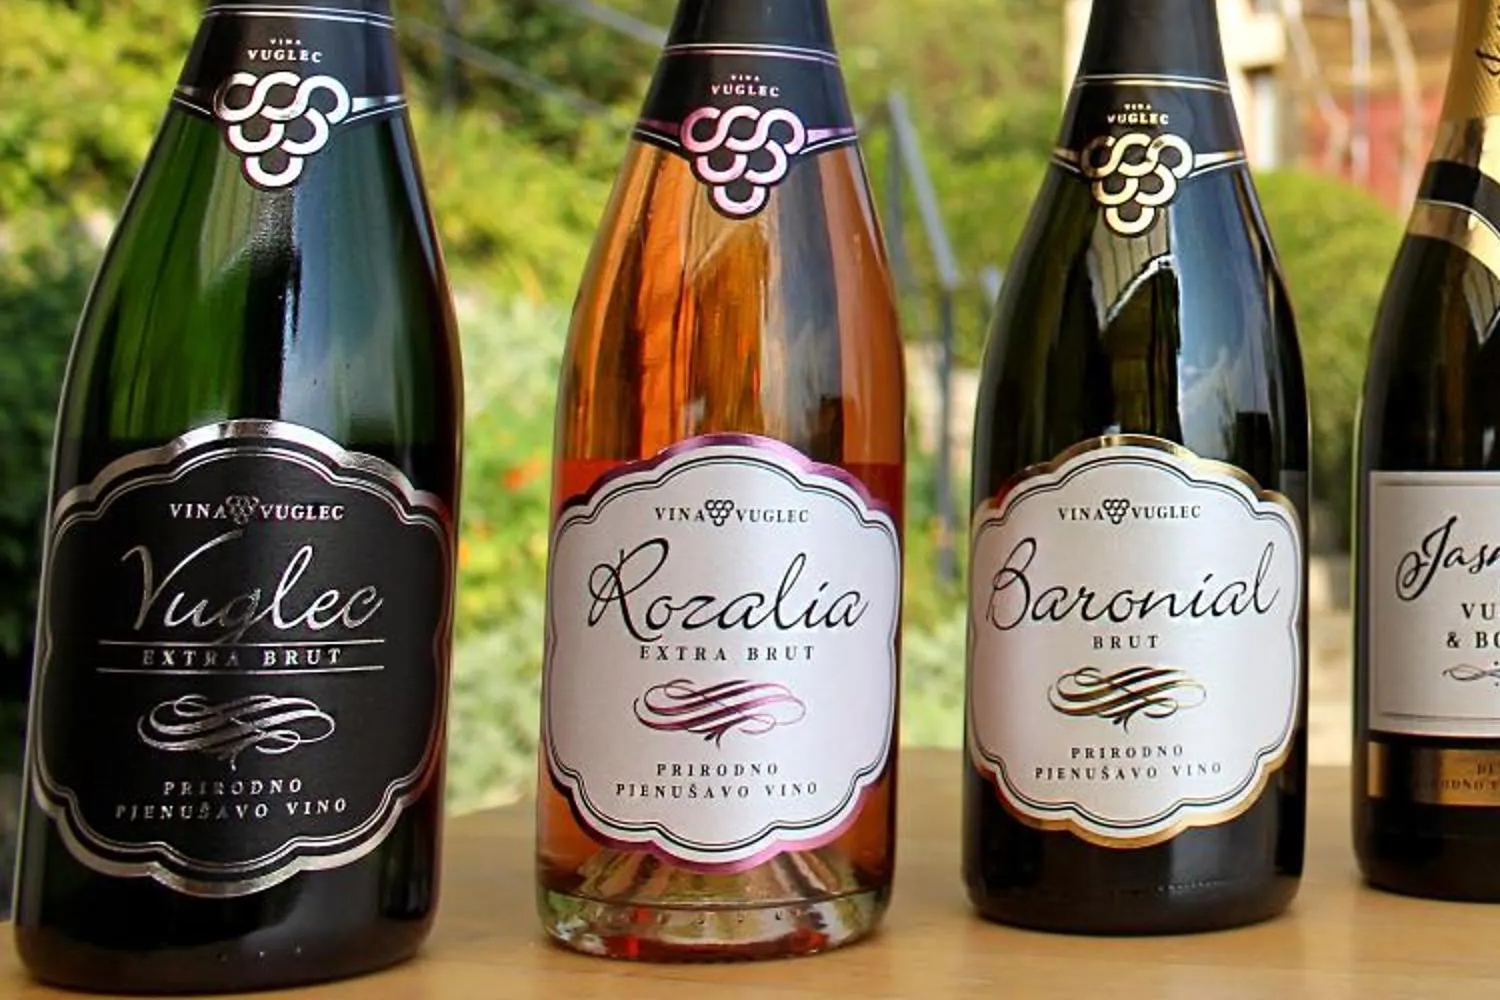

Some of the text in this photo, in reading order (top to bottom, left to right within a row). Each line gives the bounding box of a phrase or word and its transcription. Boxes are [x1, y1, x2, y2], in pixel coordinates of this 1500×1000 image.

[247, 49, 323, 63] VUGLEC
[711, 84, 780, 98] VUGLEC
[1107, 112, 1169, 125] VUGLEC
[169, 503, 345, 521] VINA VUGLEC
[655, 507, 810, 524] VINA VUGLEC
[1058, 505, 1201, 522] VINA VUGLEC
[121, 529, 384, 645] Vuglec
[587, 537, 869, 641] Rozalia
[986, 537, 1281, 630] Baronial
[1092, 635, 1160, 650] BRUT
[1446, 631, 1460, 649] &
[142, 648, 343, 667] EXTRA BRUT
[639, 645, 817, 661] EXTRA BRUT
[1071, 744, 1183, 759] PRIRODNO
[656, 763, 779, 777] PRIRODNO
[1172, 762, 1222, 777] VINO
[163, 778, 302, 796] PRIRODNO
[765, 782, 818, 797] VINO
[286, 797, 347, 815] VINO
